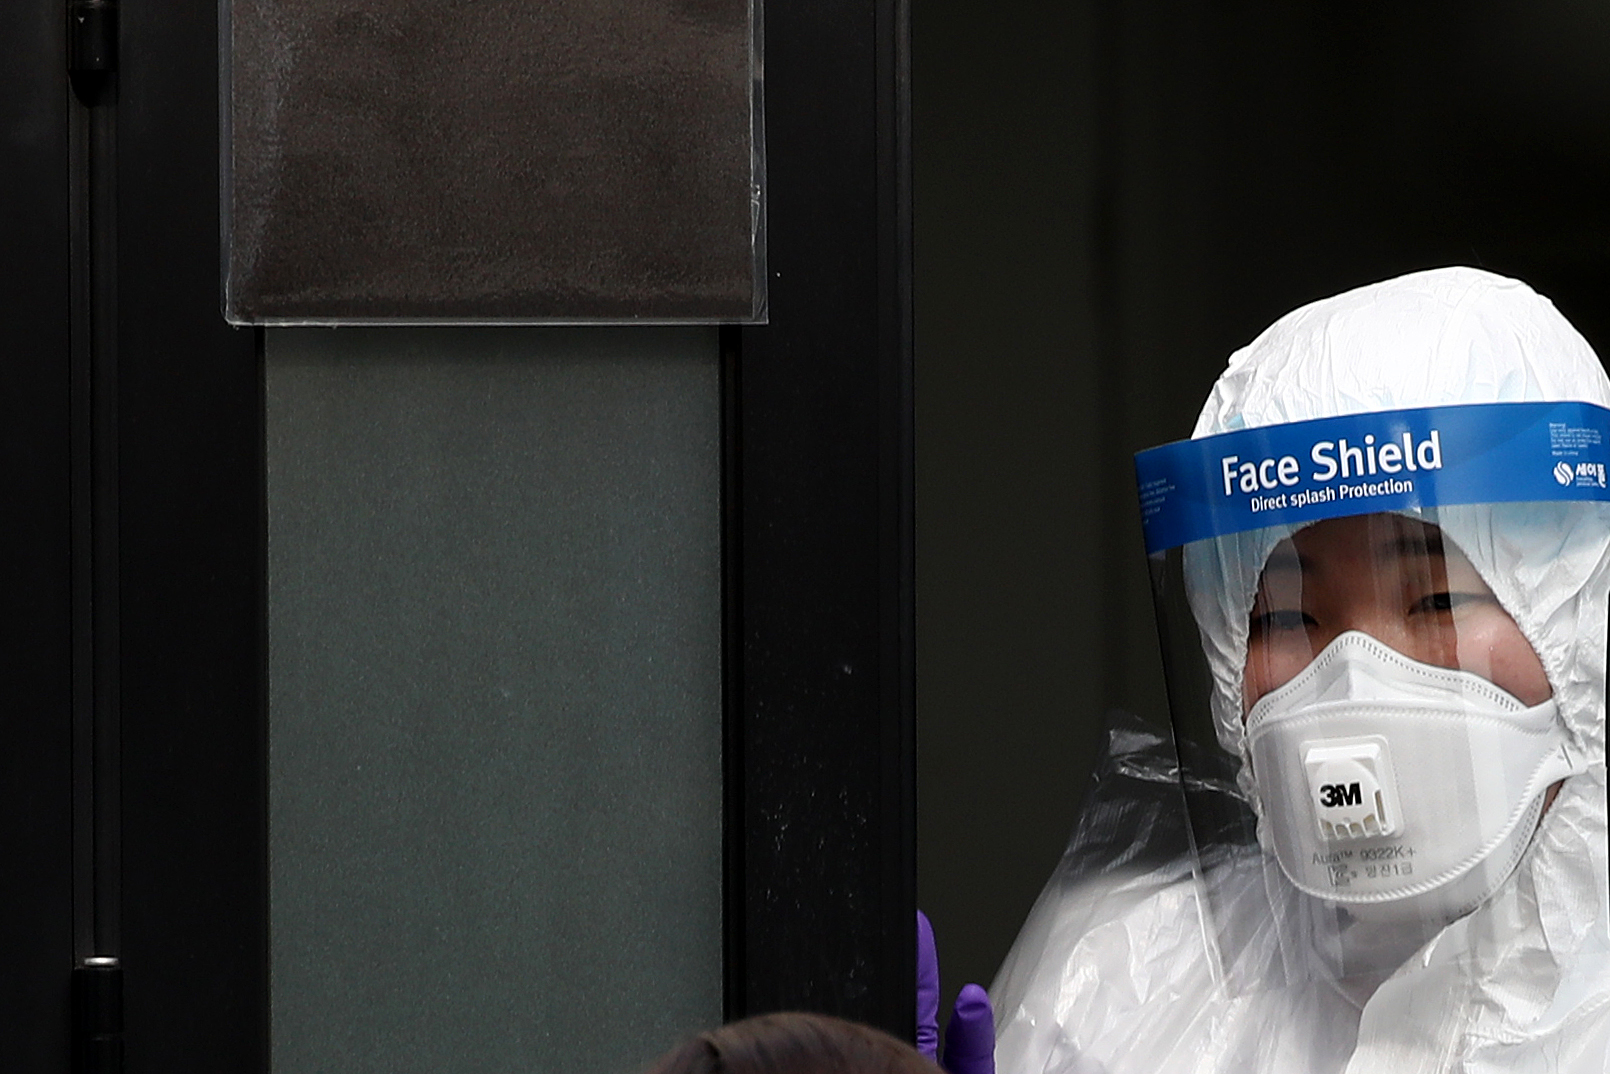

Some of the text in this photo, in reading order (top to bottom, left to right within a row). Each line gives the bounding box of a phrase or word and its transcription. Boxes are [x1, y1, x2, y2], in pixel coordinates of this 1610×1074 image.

[1221, 430, 1443, 496] Face Shield
[1251, 478, 1413, 513] Direct splash Protection
[1320, 783, 1362, 807] 3M
